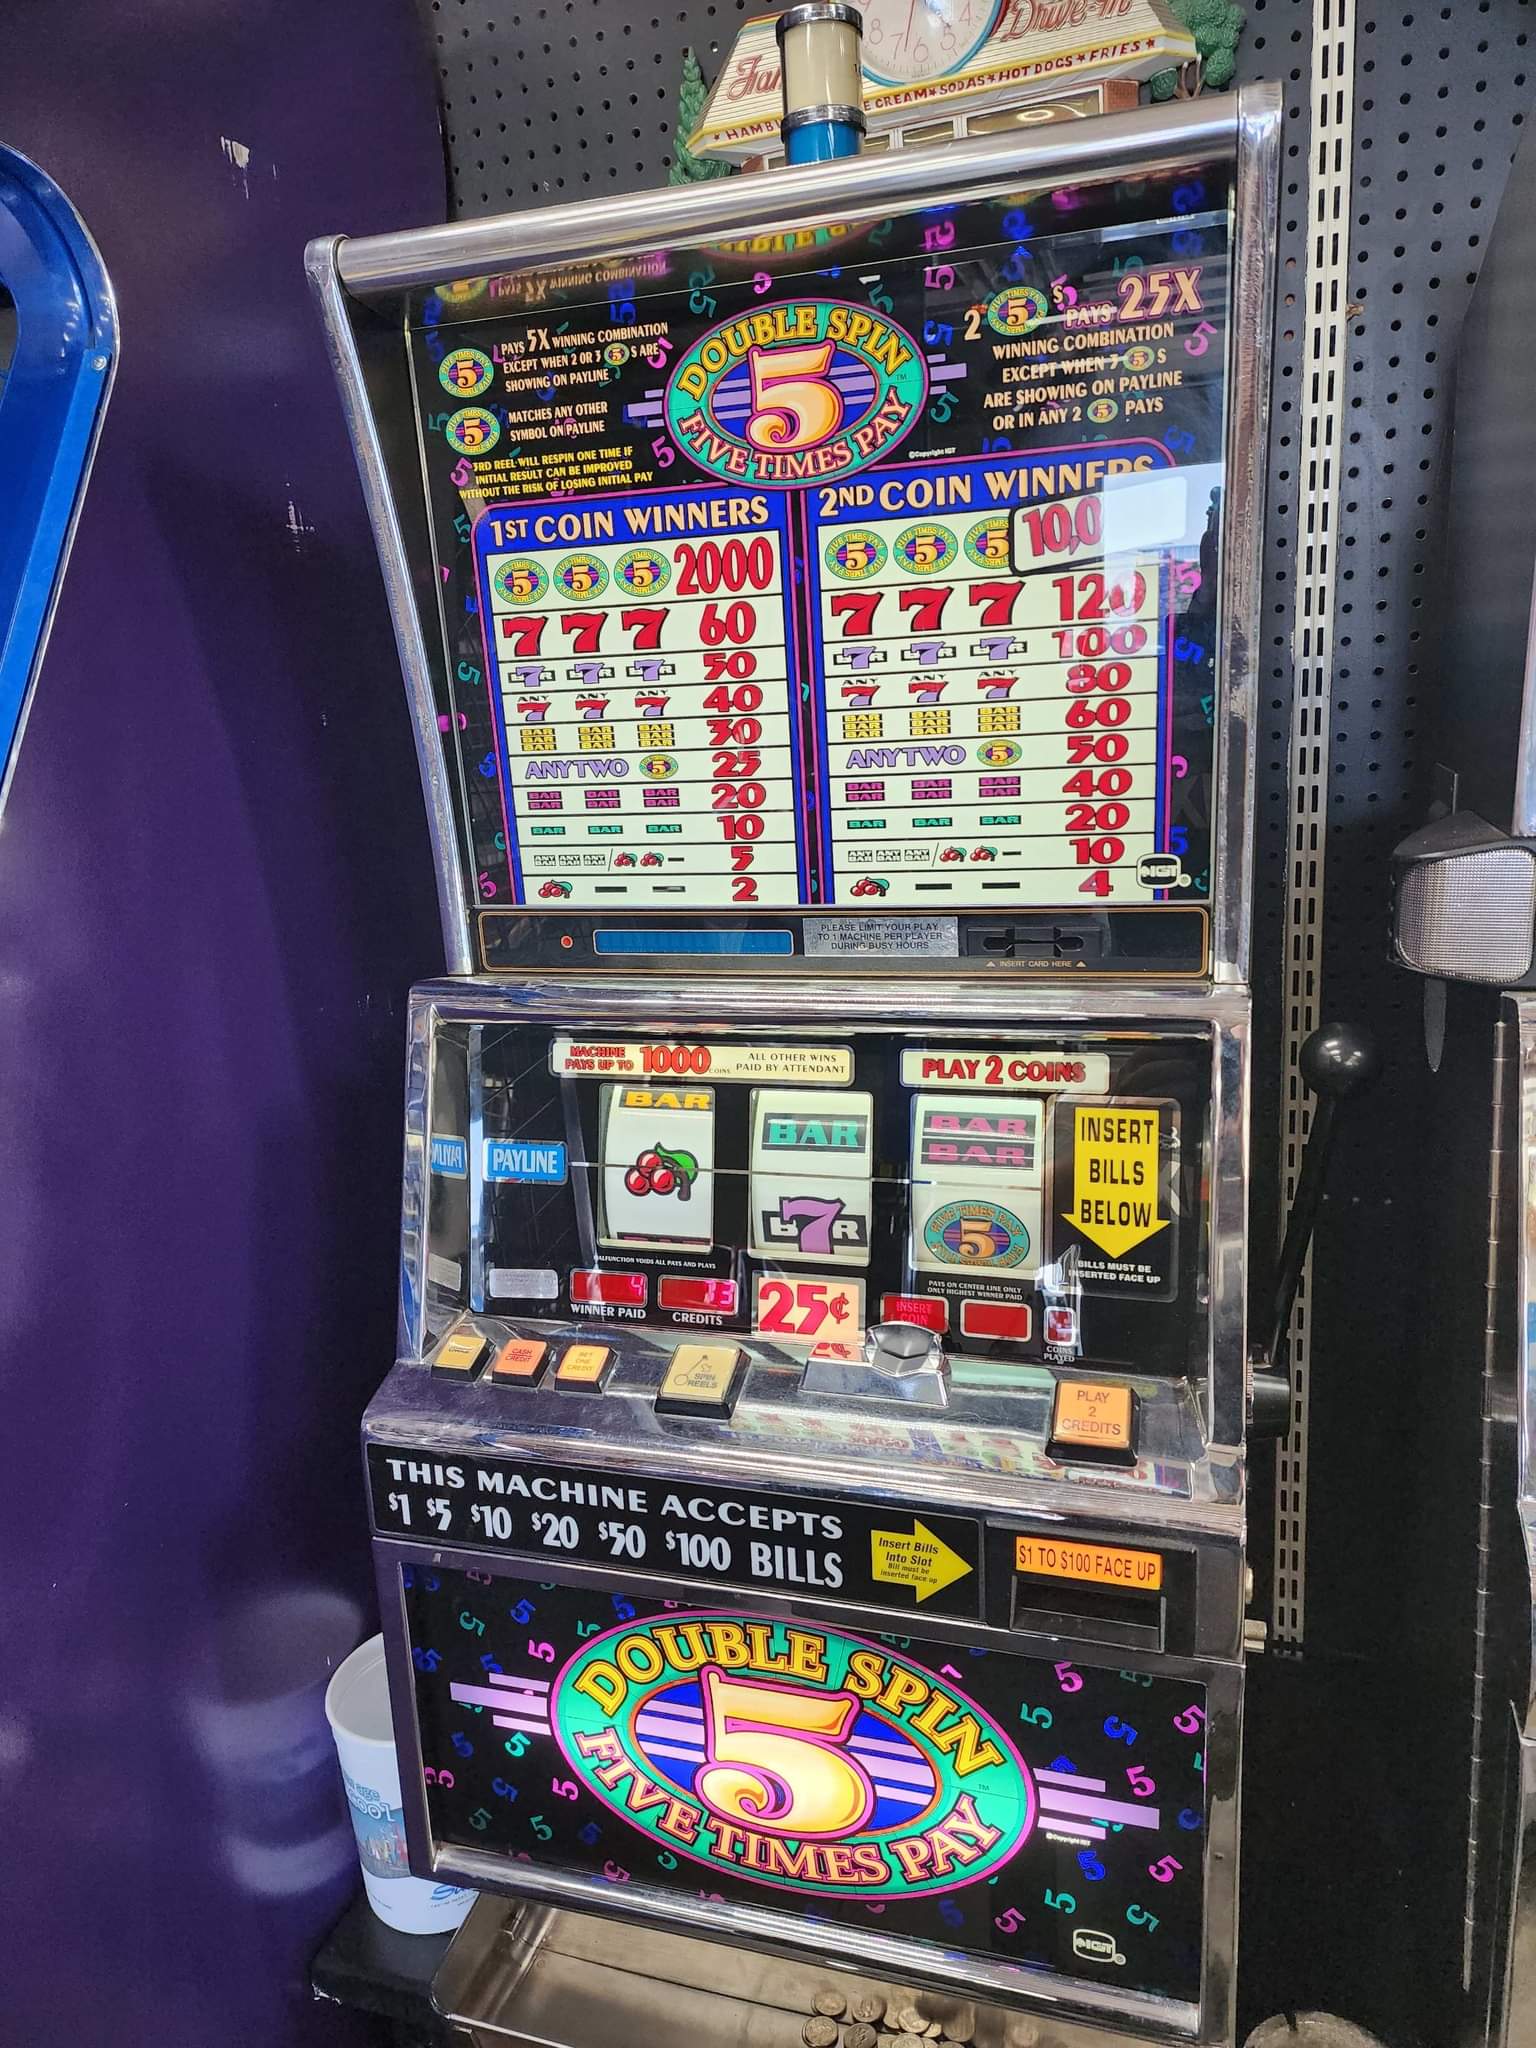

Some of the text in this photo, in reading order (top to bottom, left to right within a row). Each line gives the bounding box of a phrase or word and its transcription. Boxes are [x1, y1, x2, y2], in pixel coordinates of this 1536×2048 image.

[875, 41, 1140, 109] CREAM SODAS HOT DOGS FRIES
[964, 267, 1202, 341] 2 PAYS 25X
[501, 322, 668, 355] PAYS 5X WINNING COMBINATION
[677, 305, 912, 400] DOUBLE SPIN
[992, 323, 1174, 360] WINNING COMBINATION
[503, 344, 658, 374] EXCEPT WHEN OR ARE
[1002, 358, 1104, 383] EXCEPT WHEN
[505, 369, 609, 392] SHOWING ON PAYLINE
[984, 371, 1182, 409] ARE SHOWING ON PAYLINE
[508, 402, 607, 423] MATCHES ANY OTHER
[992, 397, 1163, 430] OR IN ANY PAYS
[510, 420, 605, 441] SYMBOL ON PAYLINE
[677, 386, 912, 479] FIVE TIMES PAY
[473, 446, 632, 471] 3RD REEL WILL RESPIN ONE TIME IF
[459, 472, 653, 499] WITHOUT THE RISK OF LOSING INITIAL PAY
[475, 461, 632, 485] INITIAL RESULT CAN BE IMPROVED
[819, 484, 874, 517] 2ND
[879, 475, 971, 511] COIN
[491, 495, 769, 546] 1ST COIN WINNERS
[674, 536, 774, 596] 2000
[699, 601, 757, 646] 60
[1052, 624, 1148, 658] 100
[704, 651, 757, 681] 50
[702, 684, 763, 712] 40
[711, 782, 767, 810] 20
[832, 942, 865, 950] DURING
[565, 1059, 634, 1071] PAYS UP TO
[570, 1046, 626, 1058] MACHINE
[640, 1045, 712, 1074] 1000
[748, 1053, 837, 1062] ALL OTHER WINS
[736, 1063, 845, 1074] PAID BY ATTENDANT
[922, 1056, 1086, 1084] PLAY 2 COINS
[768, 1119, 859, 1149] BAR
[1080, 1117, 1154, 1146] INSERT
[492, 1148, 557, 1174] PAYLINE
[1089, 1159, 1144, 1186] BILLS
[1080, 1199, 1152, 1228] BELOW
[1077, 1260, 1152, 1273] BILLS MUST BE
[1119, 1272, 1144, 1282] FACE
[1147, 1275, 1160, 1284] UP
[759, 1281, 851, 1335] 25¢
[977, 1291, 1004, 1299] WINNER
[570, 1303, 646, 1319] WINNER PAID
[672, 1312, 723, 1326] CREDITS
[1077, 1390, 1110, 1403] PLAY
[1088, 1407, 1097, 1417] 2
[1062, 1418, 1121, 1435] CREDITS
[385, 1458, 843, 1541] THIS MACHINE ACCEPTS
[389, 1492, 843, 1588] $1 $5 $10 $20 $50 $100 BILLS
[879, 1537, 939, 1554] Insert Bills
[886, 1552, 932, 1567] Into Slot
[1019, 1544, 1156, 1582] $1 TO $100 FACE UP
[880, 1570, 909, 1579] inserted
[574, 1622, 1005, 1778] DOUBLE SPIN
[575, 1726, 1005, 1884] FIVE TIMES PAY
